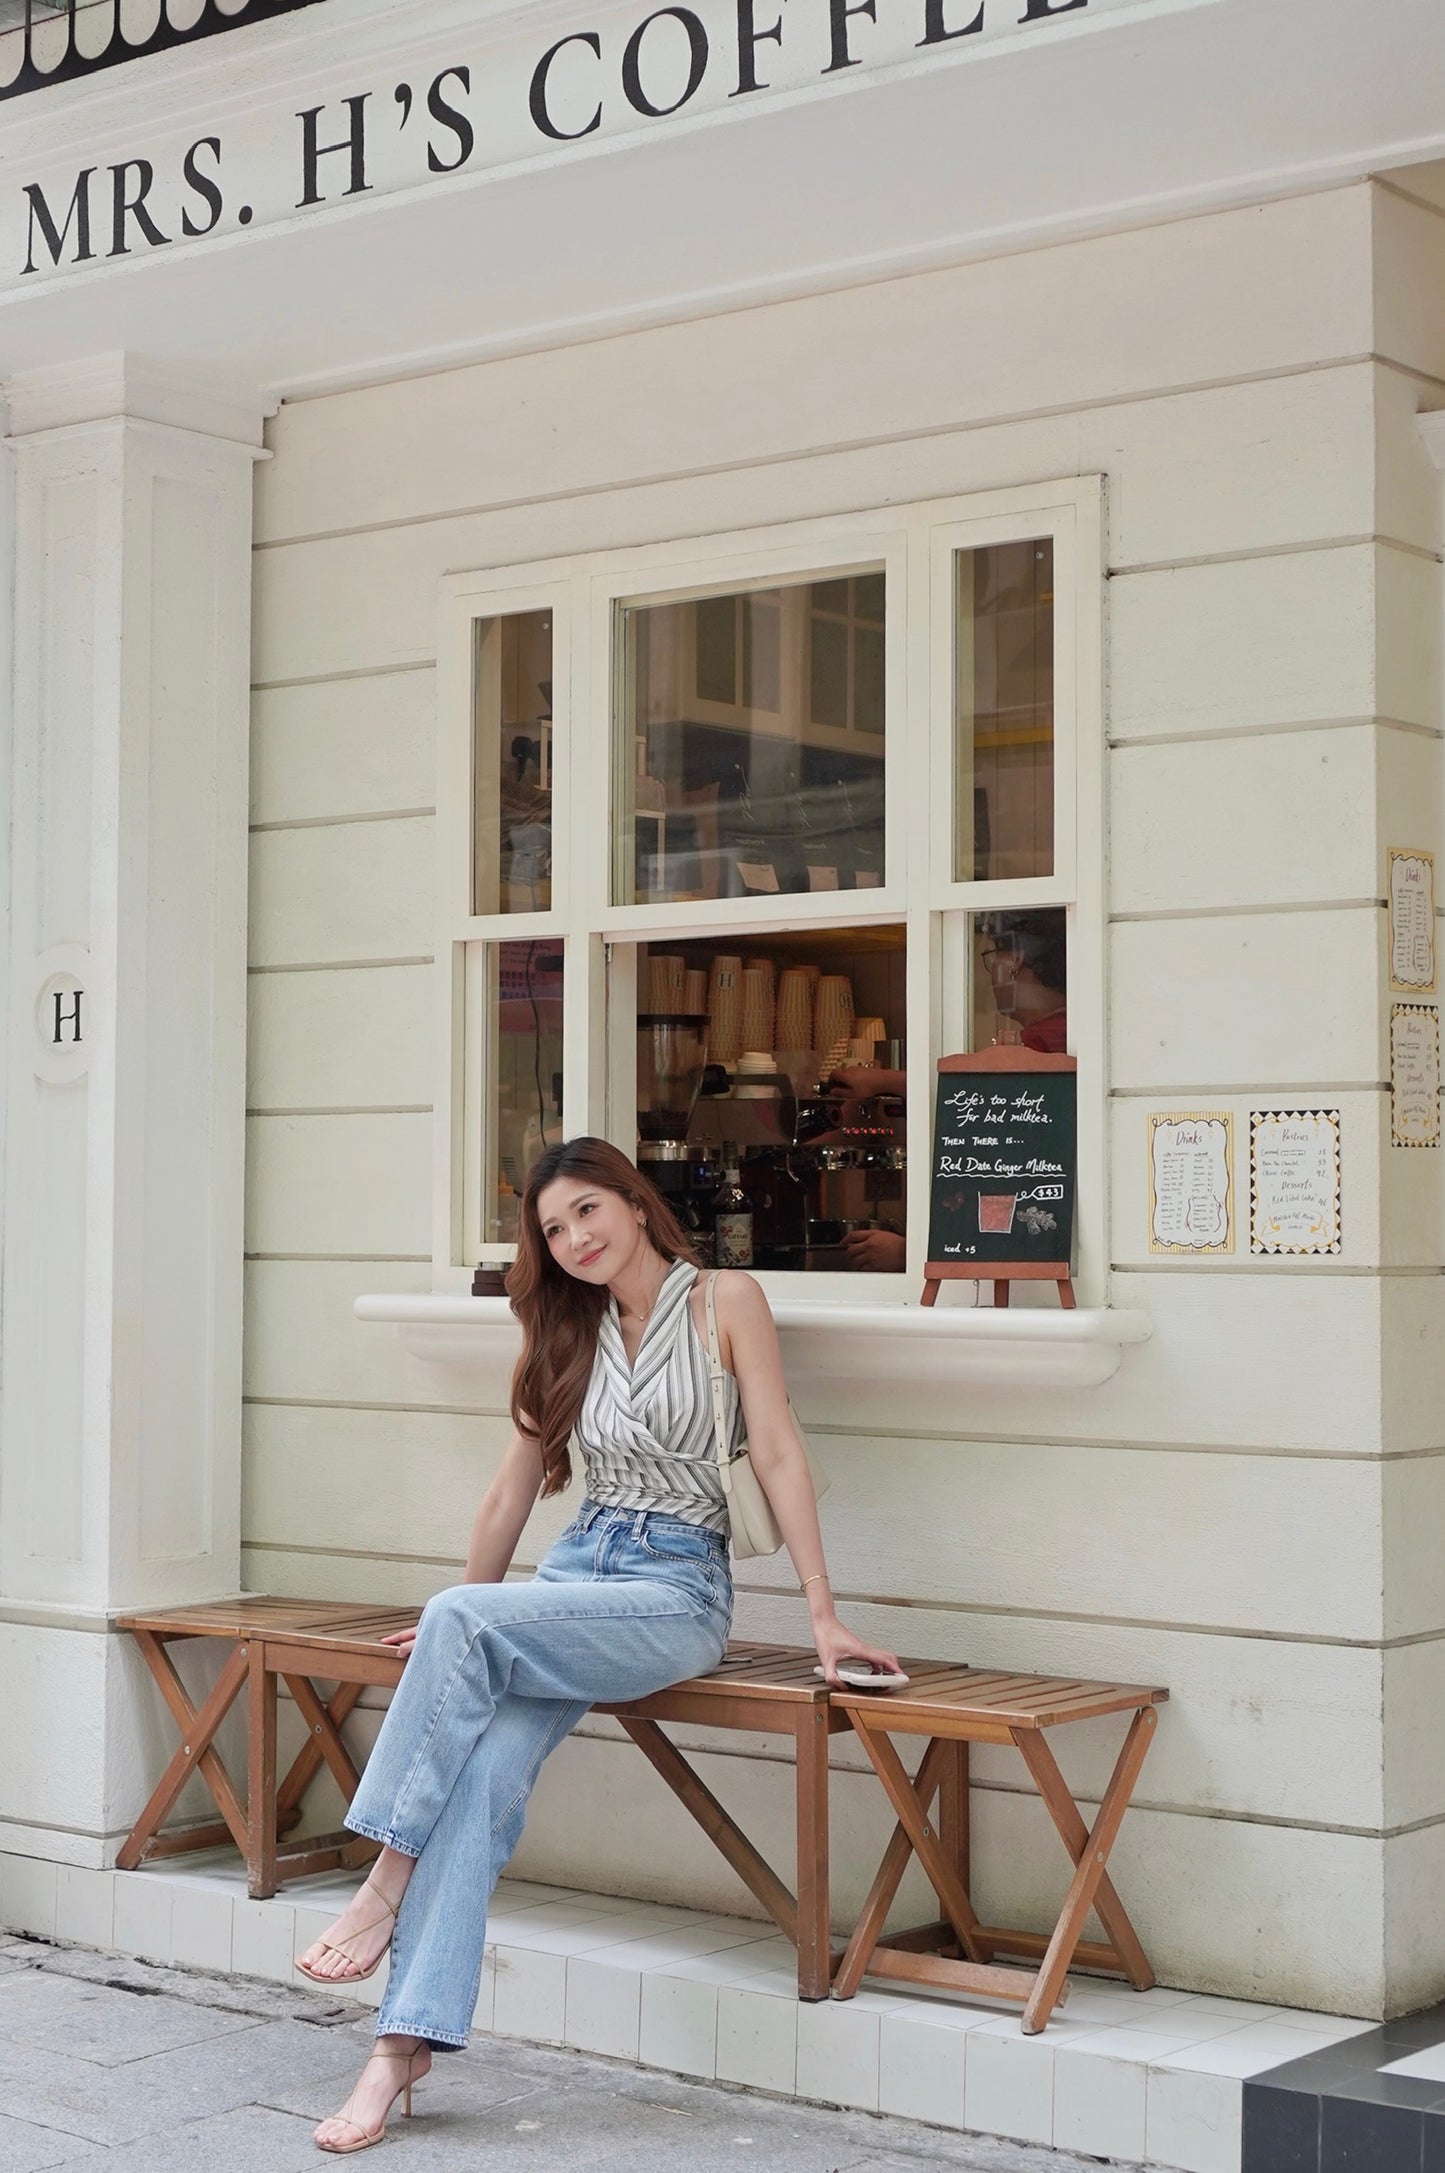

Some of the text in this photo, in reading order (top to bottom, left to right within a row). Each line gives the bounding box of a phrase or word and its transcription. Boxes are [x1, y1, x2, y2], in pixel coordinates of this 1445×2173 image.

[20, 0, 1088, 275] MRS. H'S COFF
[53, 991, 84, 1043] H
[944, 1090, 1044, 1112] Life's too short
[956, 1108, 1053, 1127] for bad milktea.
[941, 1136, 966, 1146] THEN
[971, 1136, 1000, 1146] THERE
[1175, 1130, 1203, 1146] Drinks
[940, 1156, 1063, 1176] Red Date Ginger Milktea
[944, 1243, 961, 1253] iced
